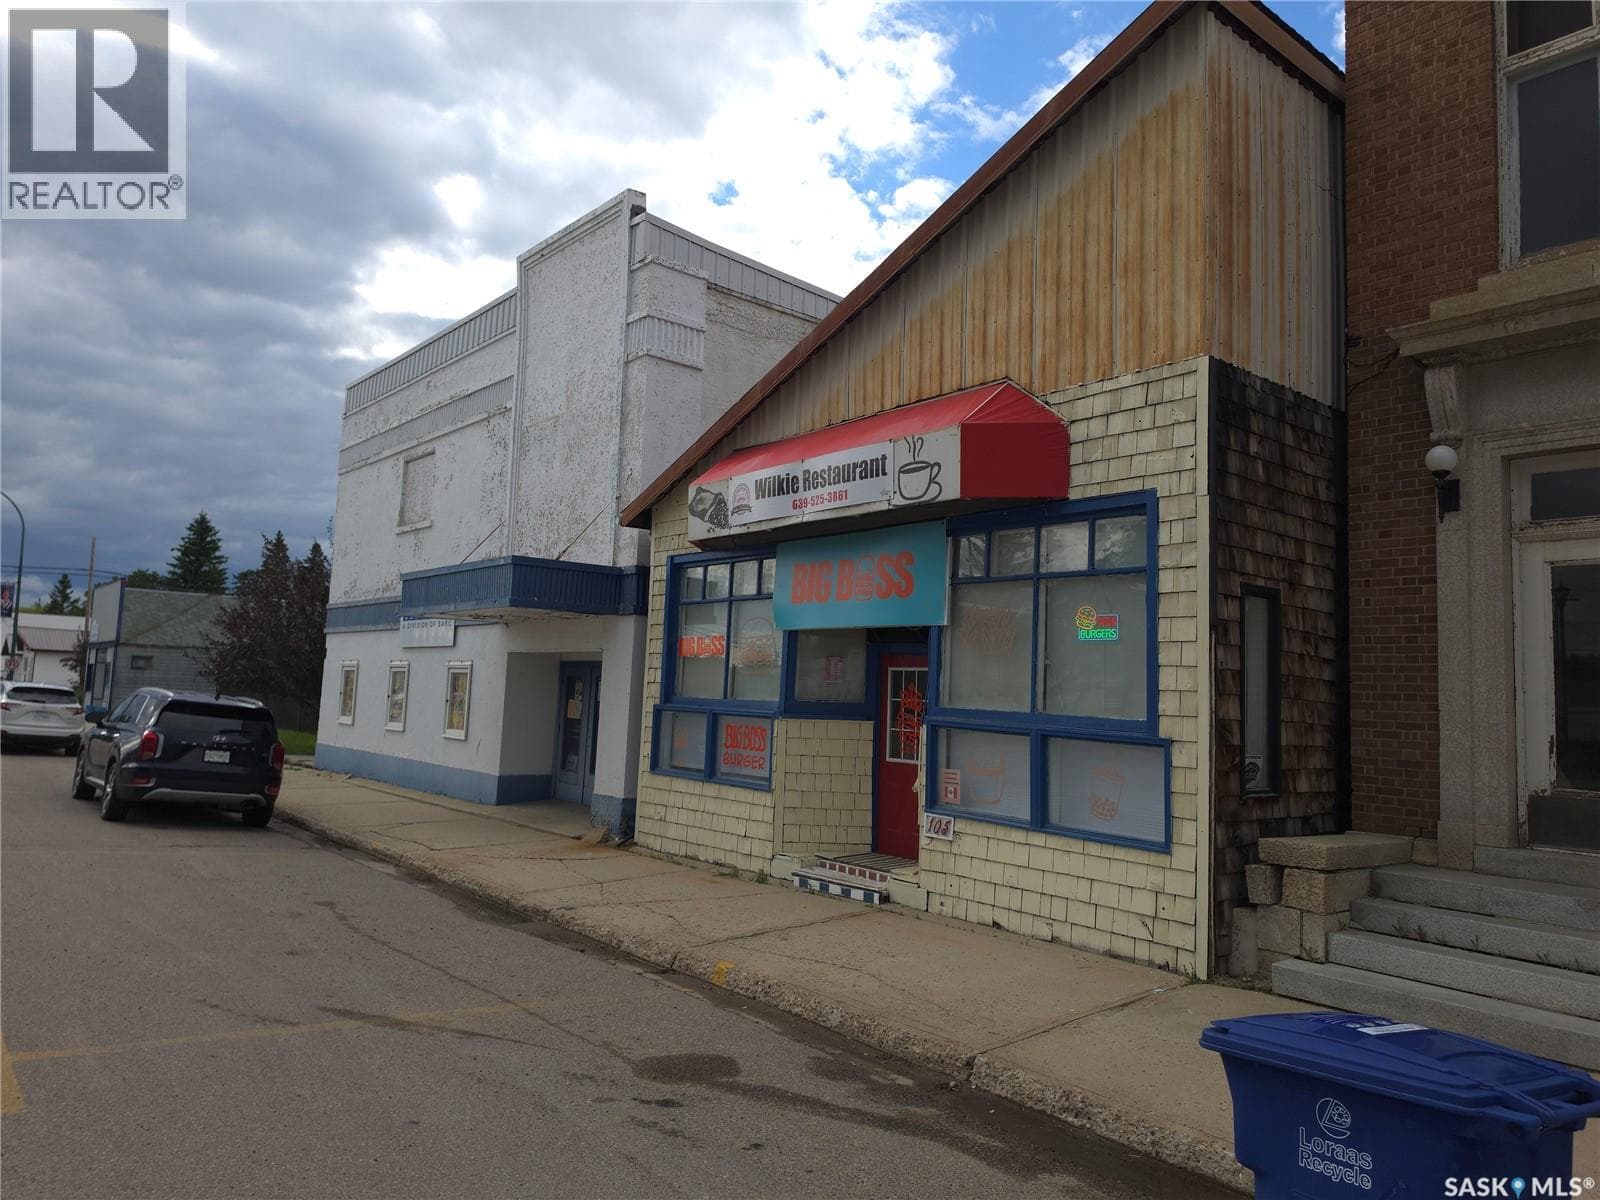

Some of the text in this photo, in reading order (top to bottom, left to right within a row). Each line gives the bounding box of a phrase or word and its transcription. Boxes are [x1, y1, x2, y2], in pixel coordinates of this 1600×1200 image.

[754, 452, 888, 501] Wilkie Restaurant
[791, 488, 849, 510] 639-525-3861
[791, 550, 915, 604] BIG BOSS
[407, 621, 428, 629] DIVISION
[429, 620, 437, 628] OF
[1080, 628, 1117, 640] BURGERS
[678, 634, 726, 657] BIG BOSS
[724, 723, 767, 752] BIG BOSS
[723, 752, 766, 770] BURGER
[927, 817, 952, 835] 105
[1299, 1126, 1373, 1170] Loraas
[1299, 1147, 1372, 1190] Recycle
